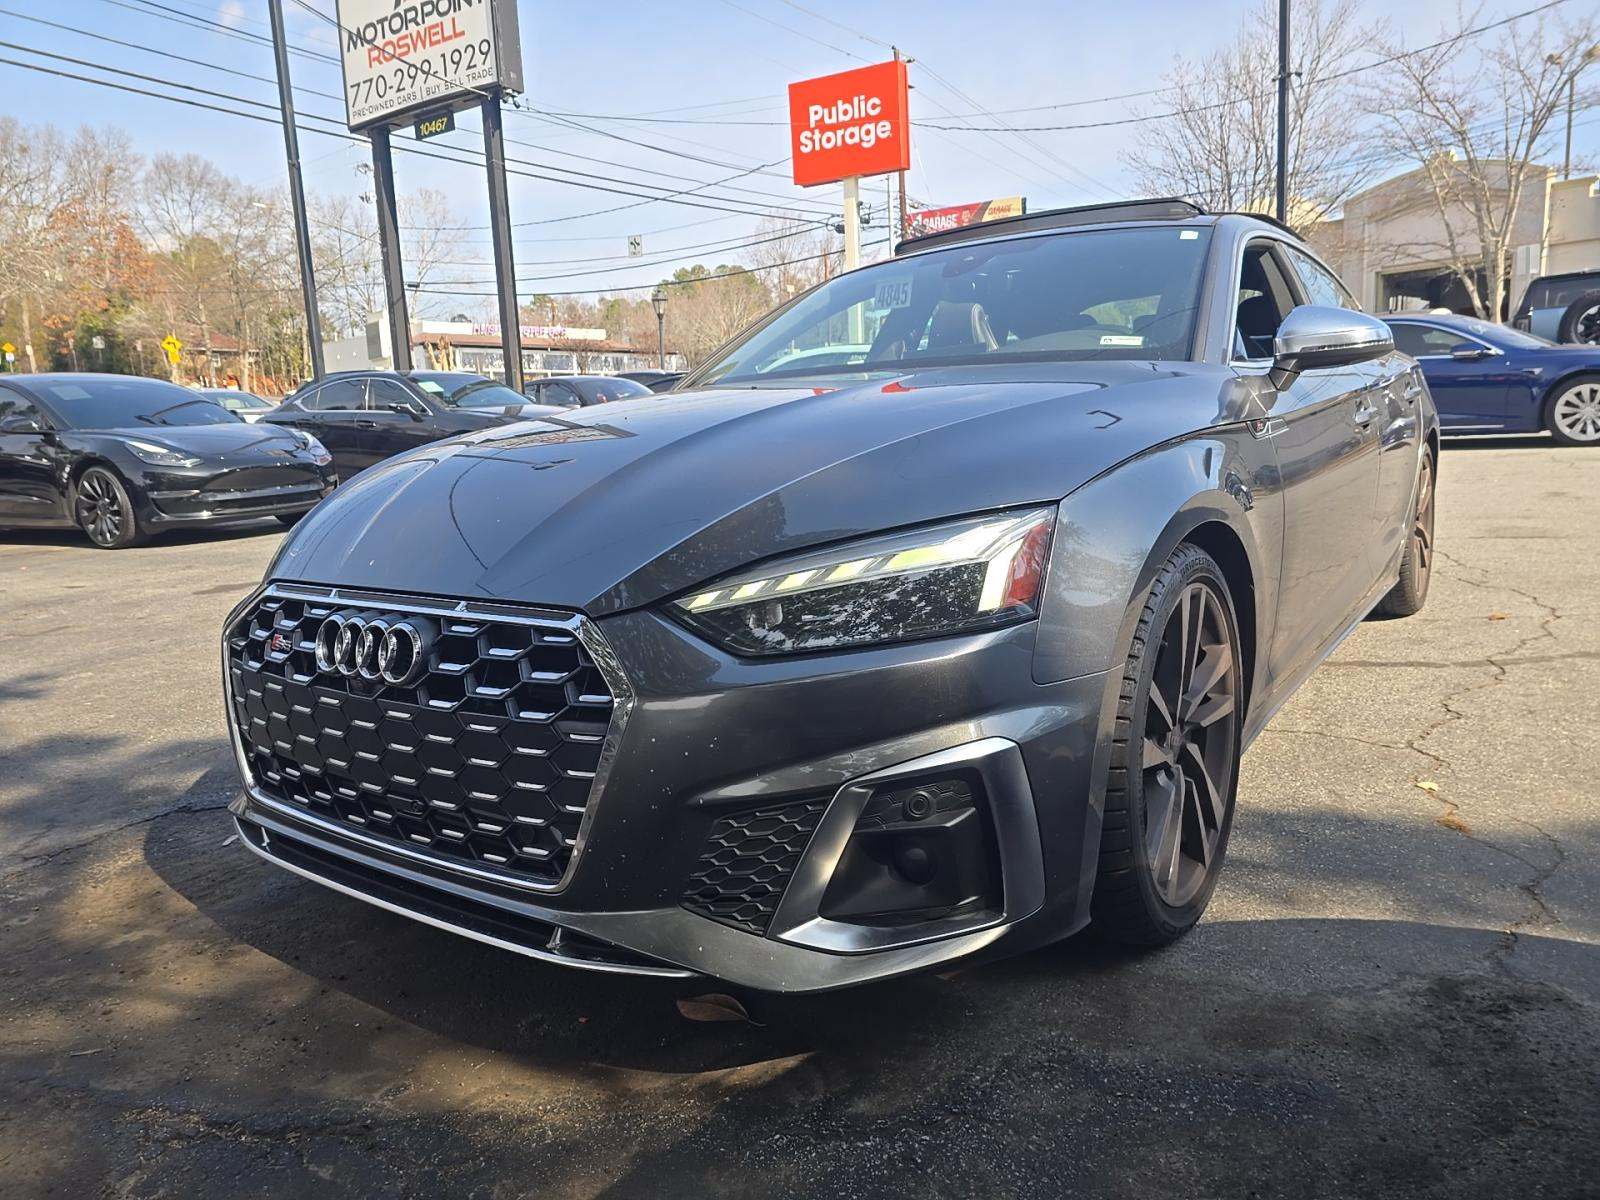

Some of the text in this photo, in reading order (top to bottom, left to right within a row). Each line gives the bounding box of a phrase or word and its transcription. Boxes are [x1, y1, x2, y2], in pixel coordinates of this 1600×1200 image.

[347, 0, 482, 52] MOTORPOI
[368, 16, 465, 68] ROSWELL
[350, 39, 491, 108] 770-299-1929
[352, 99, 395, 118] PRE-OWNED
[396, 91, 418, 105] CARS
[425, 83, 441, 96] BUY
[466, 67, 493, 81] TRADE
[420, 117, 447, 136] 10467
[800, 120, 892, 153] Storage
[809, 95, 881, 128] Public
